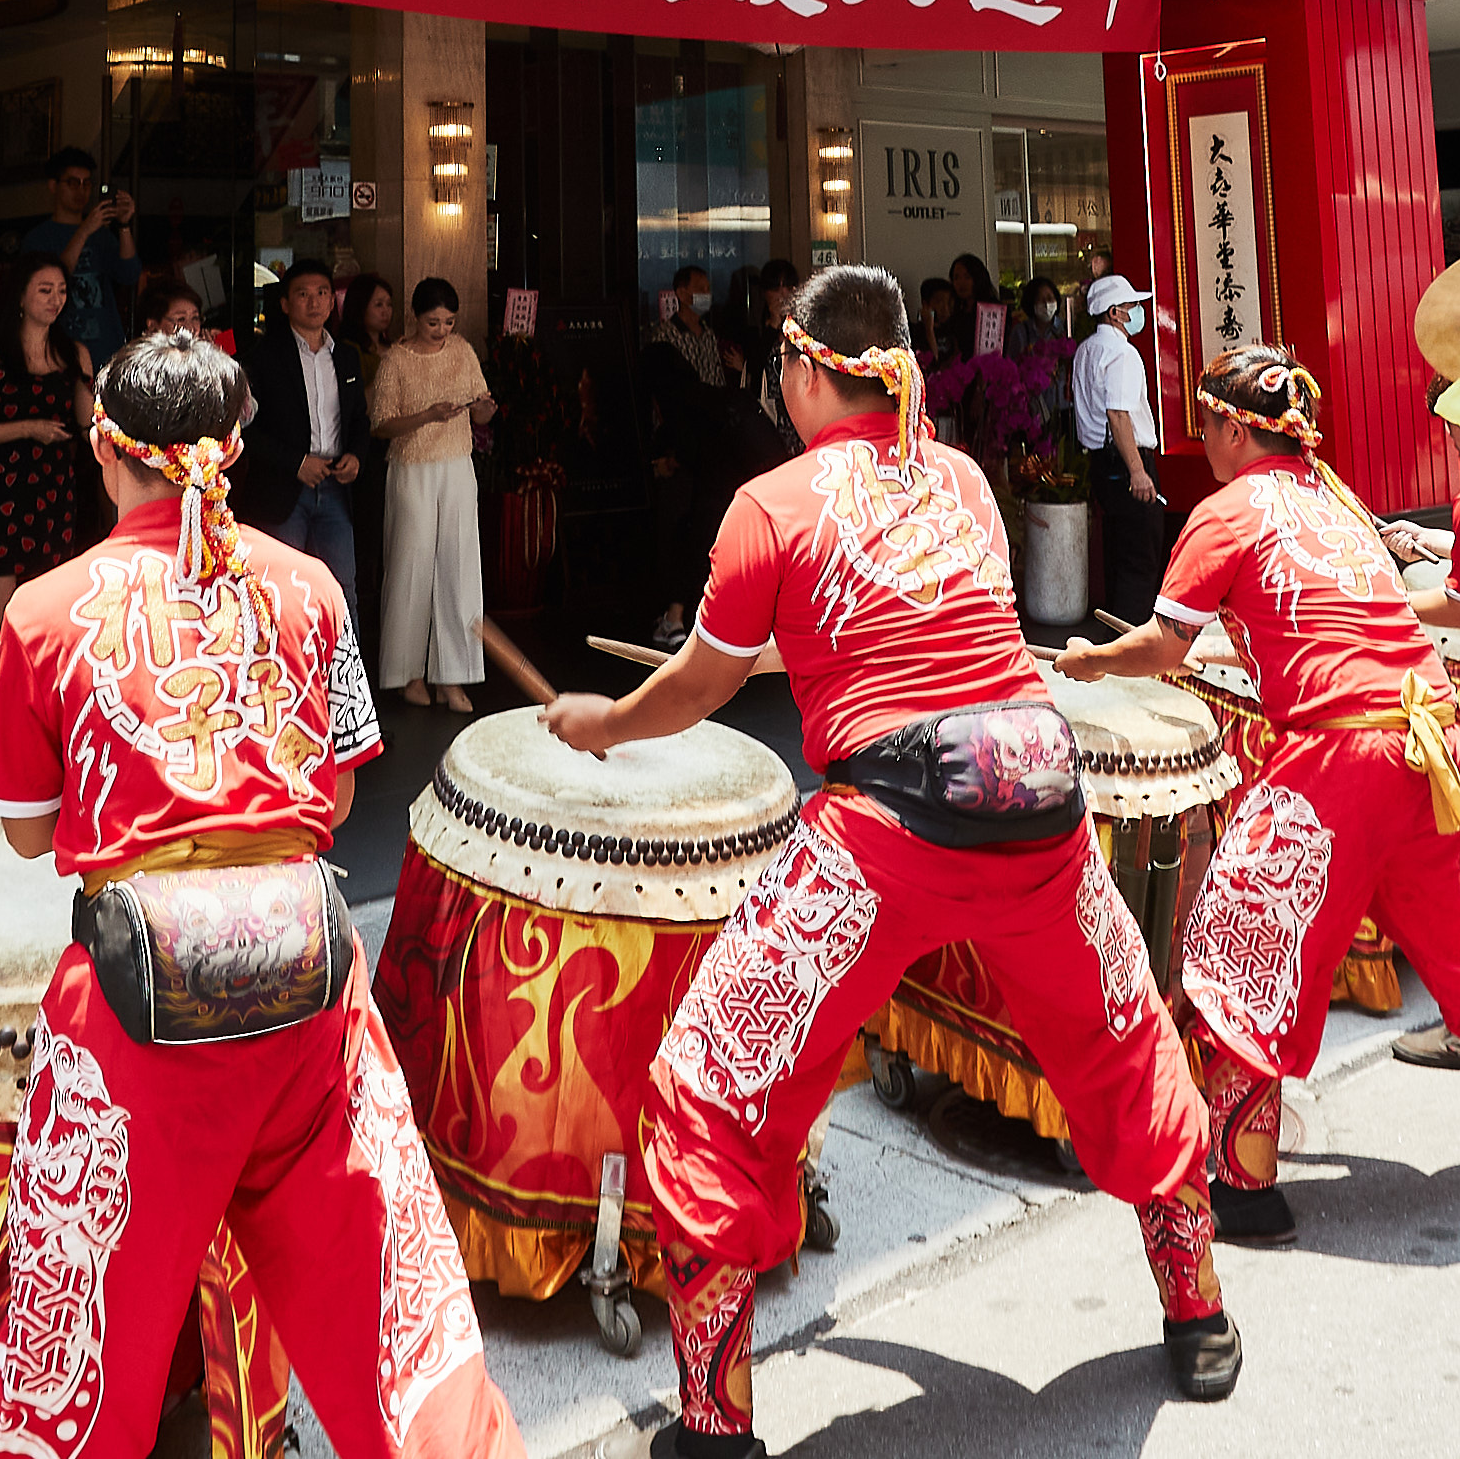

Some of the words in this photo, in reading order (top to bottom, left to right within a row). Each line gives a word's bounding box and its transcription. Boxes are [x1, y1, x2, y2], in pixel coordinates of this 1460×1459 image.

[885, 146, 961, 199] IRIS
[904, 206, 946, 220] OUTLET
[817, 252, 832, 265] 46
